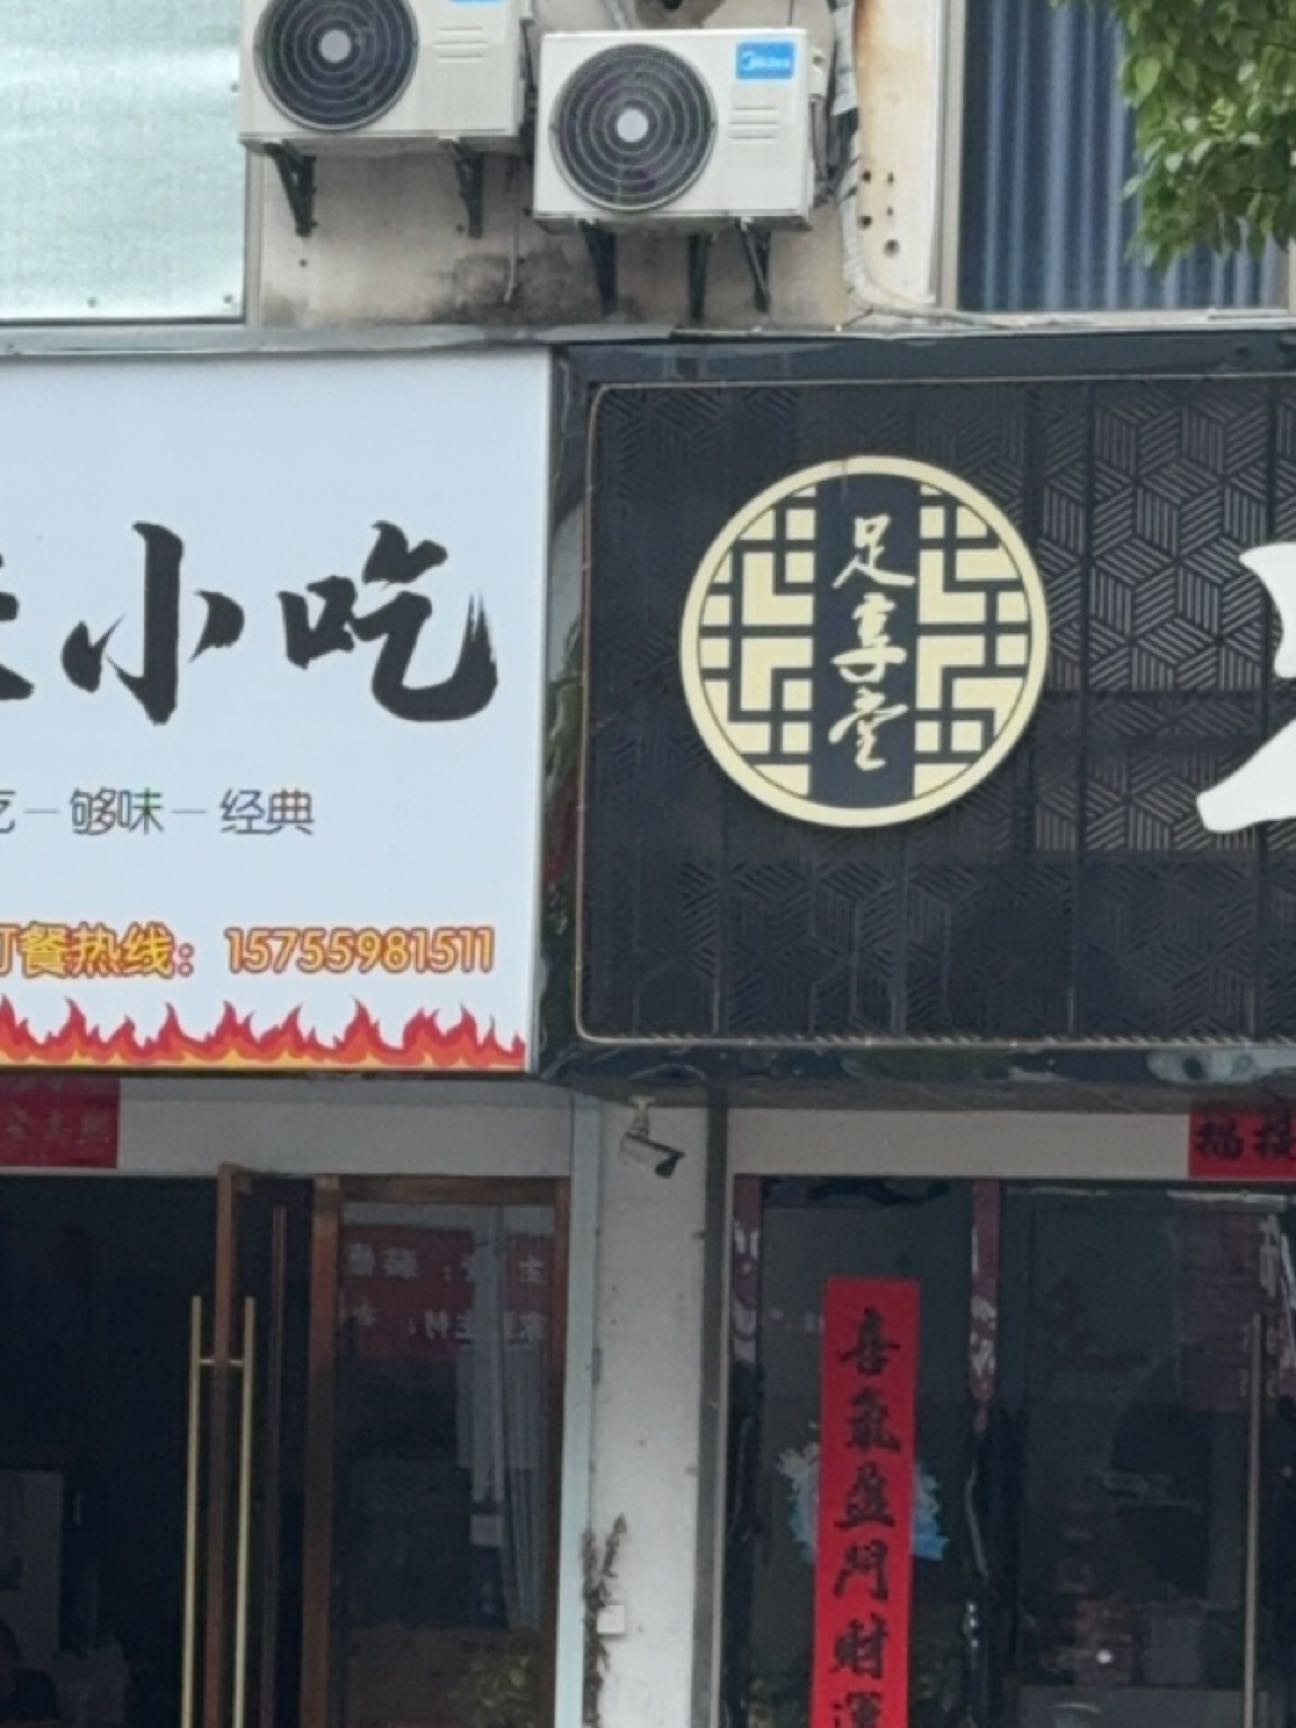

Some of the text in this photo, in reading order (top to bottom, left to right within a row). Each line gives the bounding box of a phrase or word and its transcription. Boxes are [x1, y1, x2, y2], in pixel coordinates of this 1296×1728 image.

[828, 513, 915, 771] 足享堂
[225, 927, 494, 973] 15755981511
